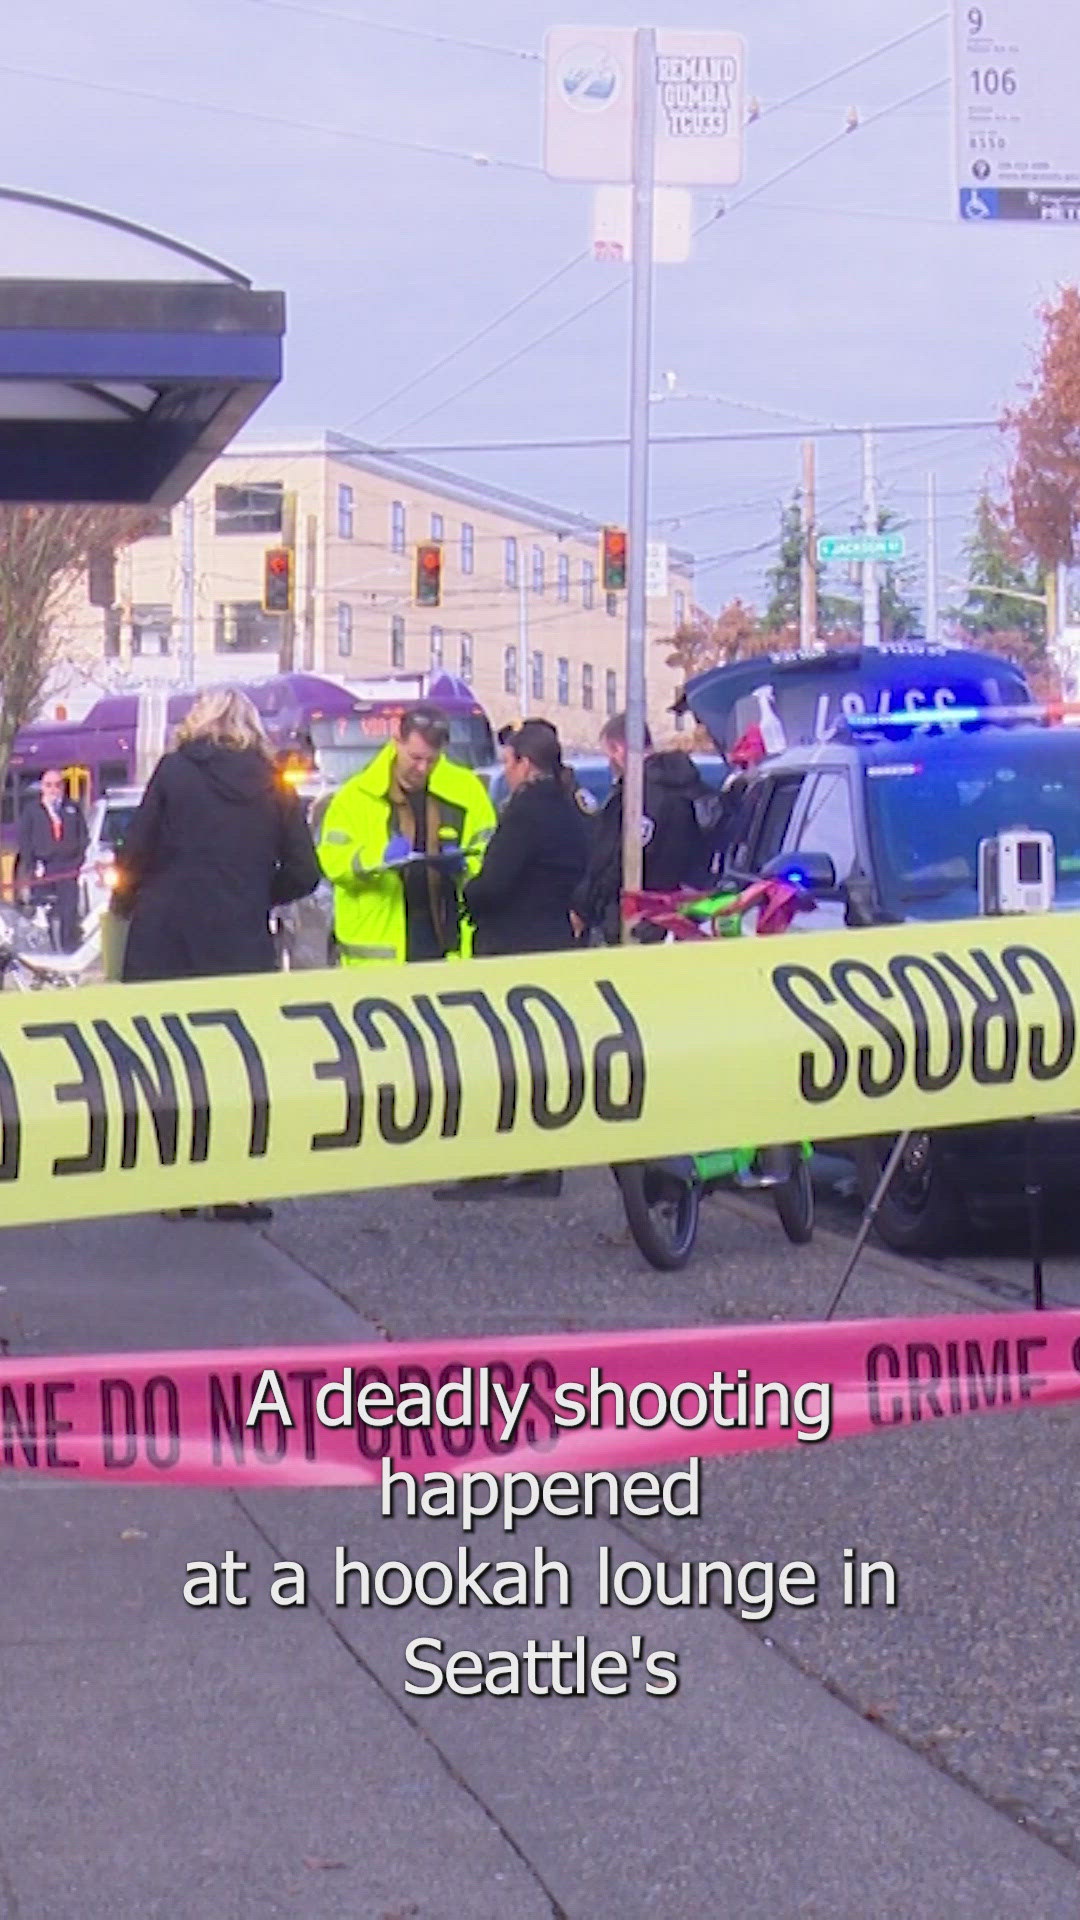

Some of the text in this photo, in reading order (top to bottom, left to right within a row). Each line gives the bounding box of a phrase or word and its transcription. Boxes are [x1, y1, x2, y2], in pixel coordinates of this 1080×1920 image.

[968, 7, 983, 35] 9
[971, 67, 1017, 95] 106
[281, 981, 646, 1152] POLICE
[772, 946, 1076, 1103] CROSS
[22, 1009, 271, 1176] LINE
[101, 1374, 181, 1469] DO
[209, 1369, 328, 1467] NOT
